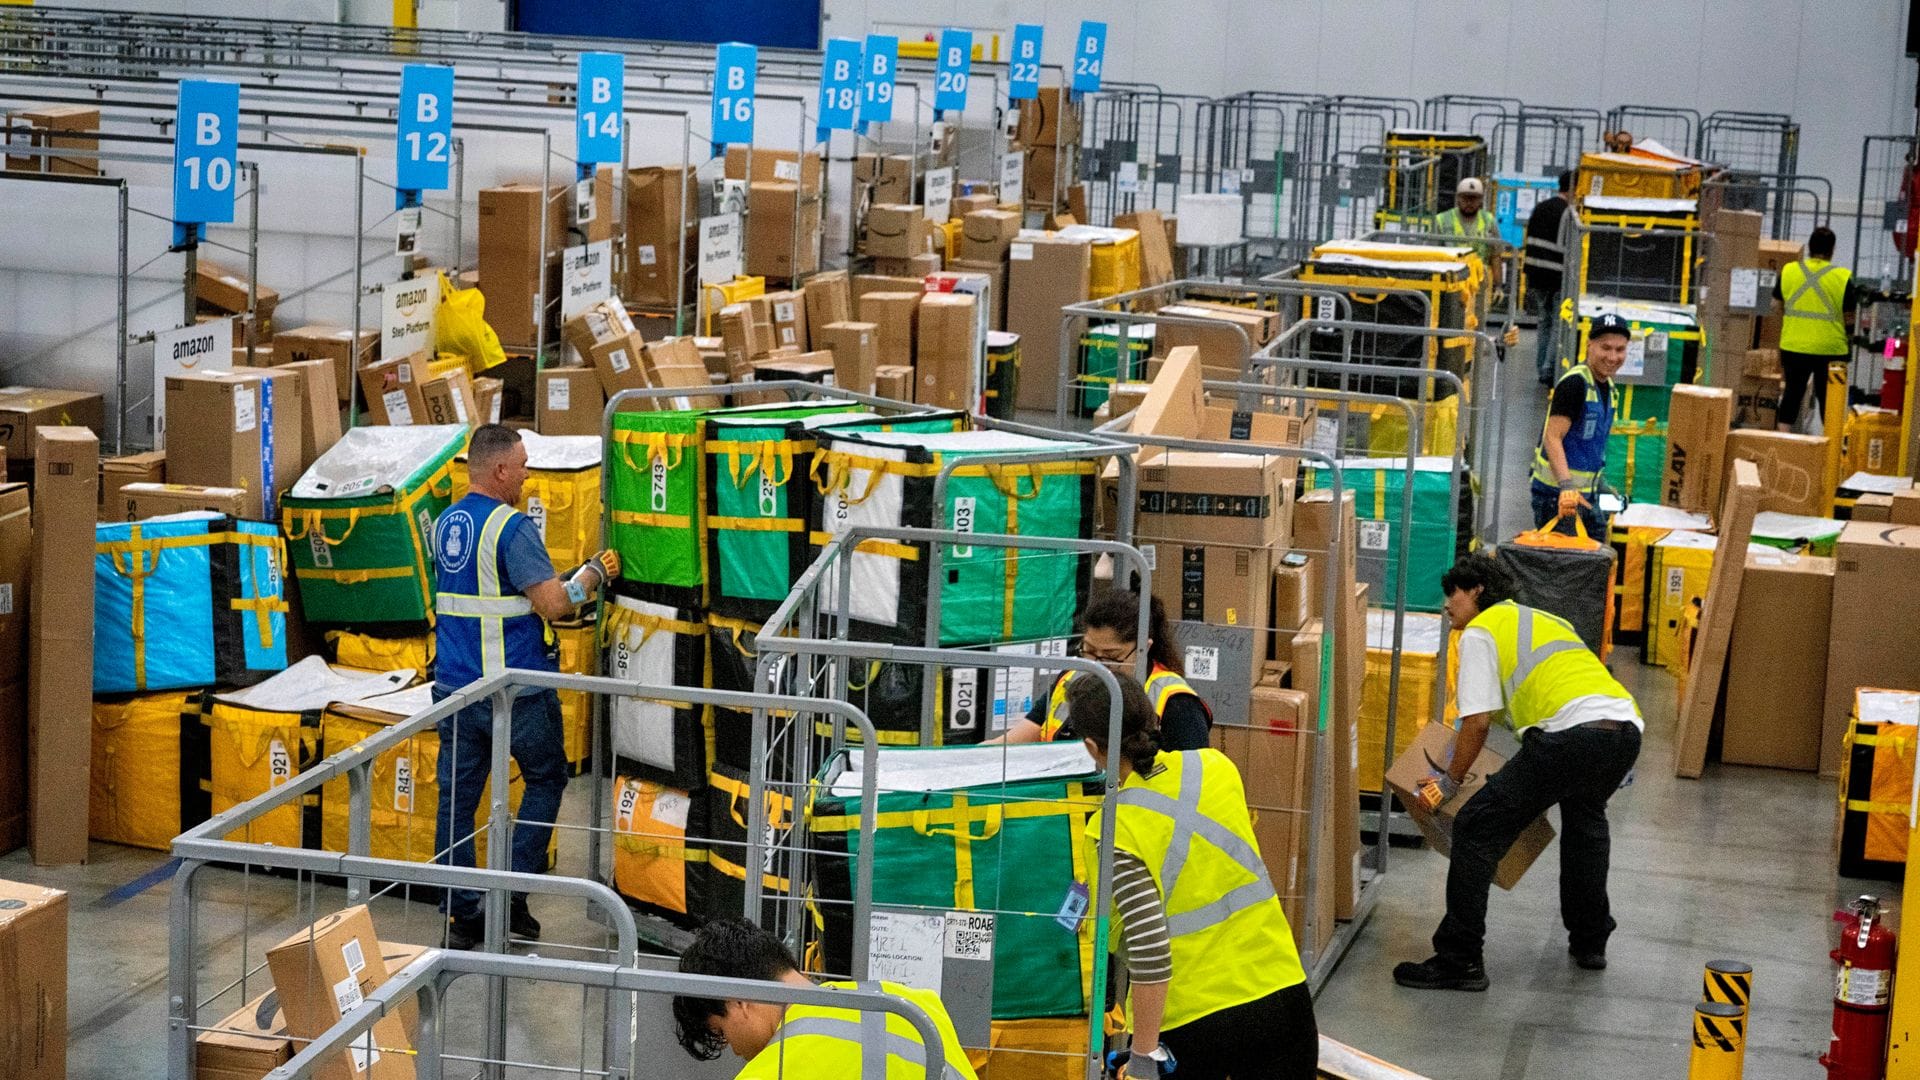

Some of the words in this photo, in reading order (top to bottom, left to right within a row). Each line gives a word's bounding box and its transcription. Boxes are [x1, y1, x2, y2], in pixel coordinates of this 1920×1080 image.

[1021, 40, 1035, 59] B
[1085, 36, 1098, 54] B
[872, 54, 888, 75] B
[948, 47, 962, 67] B
[1076, 57, 1100, 76] 24
[727, 66, 745, 91] B
[834, 59, 850, 81] B
[1013, 63, 1038, 82] 22
[591, 77, 611, 104] B
[865, 81, 892, 104] 19
[938, 71, 966, 93] 20
[416, 93, 439, 123] B
[718, 97, 750, 122] 16
[825, 87, 854, 110] 18
[195, 112, 222, 146] B
[582, 111, 620, 139] 14
[405, 131, 447, 162] 12
[183, 156, 232, 192] 10
[395, 287, 428, 310] amazon
[1320, 300, 1332, 319] 018
[391, 324, 405, 339] Step
[405, 321, 431, 337] Platform
[173, 334, 215, 360] amazon
[430, 396, 445, 425] POO
[654, 464, 664, 491] 743
[1670, 575, 1682, 592] 193
[958, 682, 973, 708] 021
[272, 751, 288, 775] 921
[398, 768, 410, 794] 843
[620, 790, 636, 815] 192
[870, 952, 891, 960] TAGING
